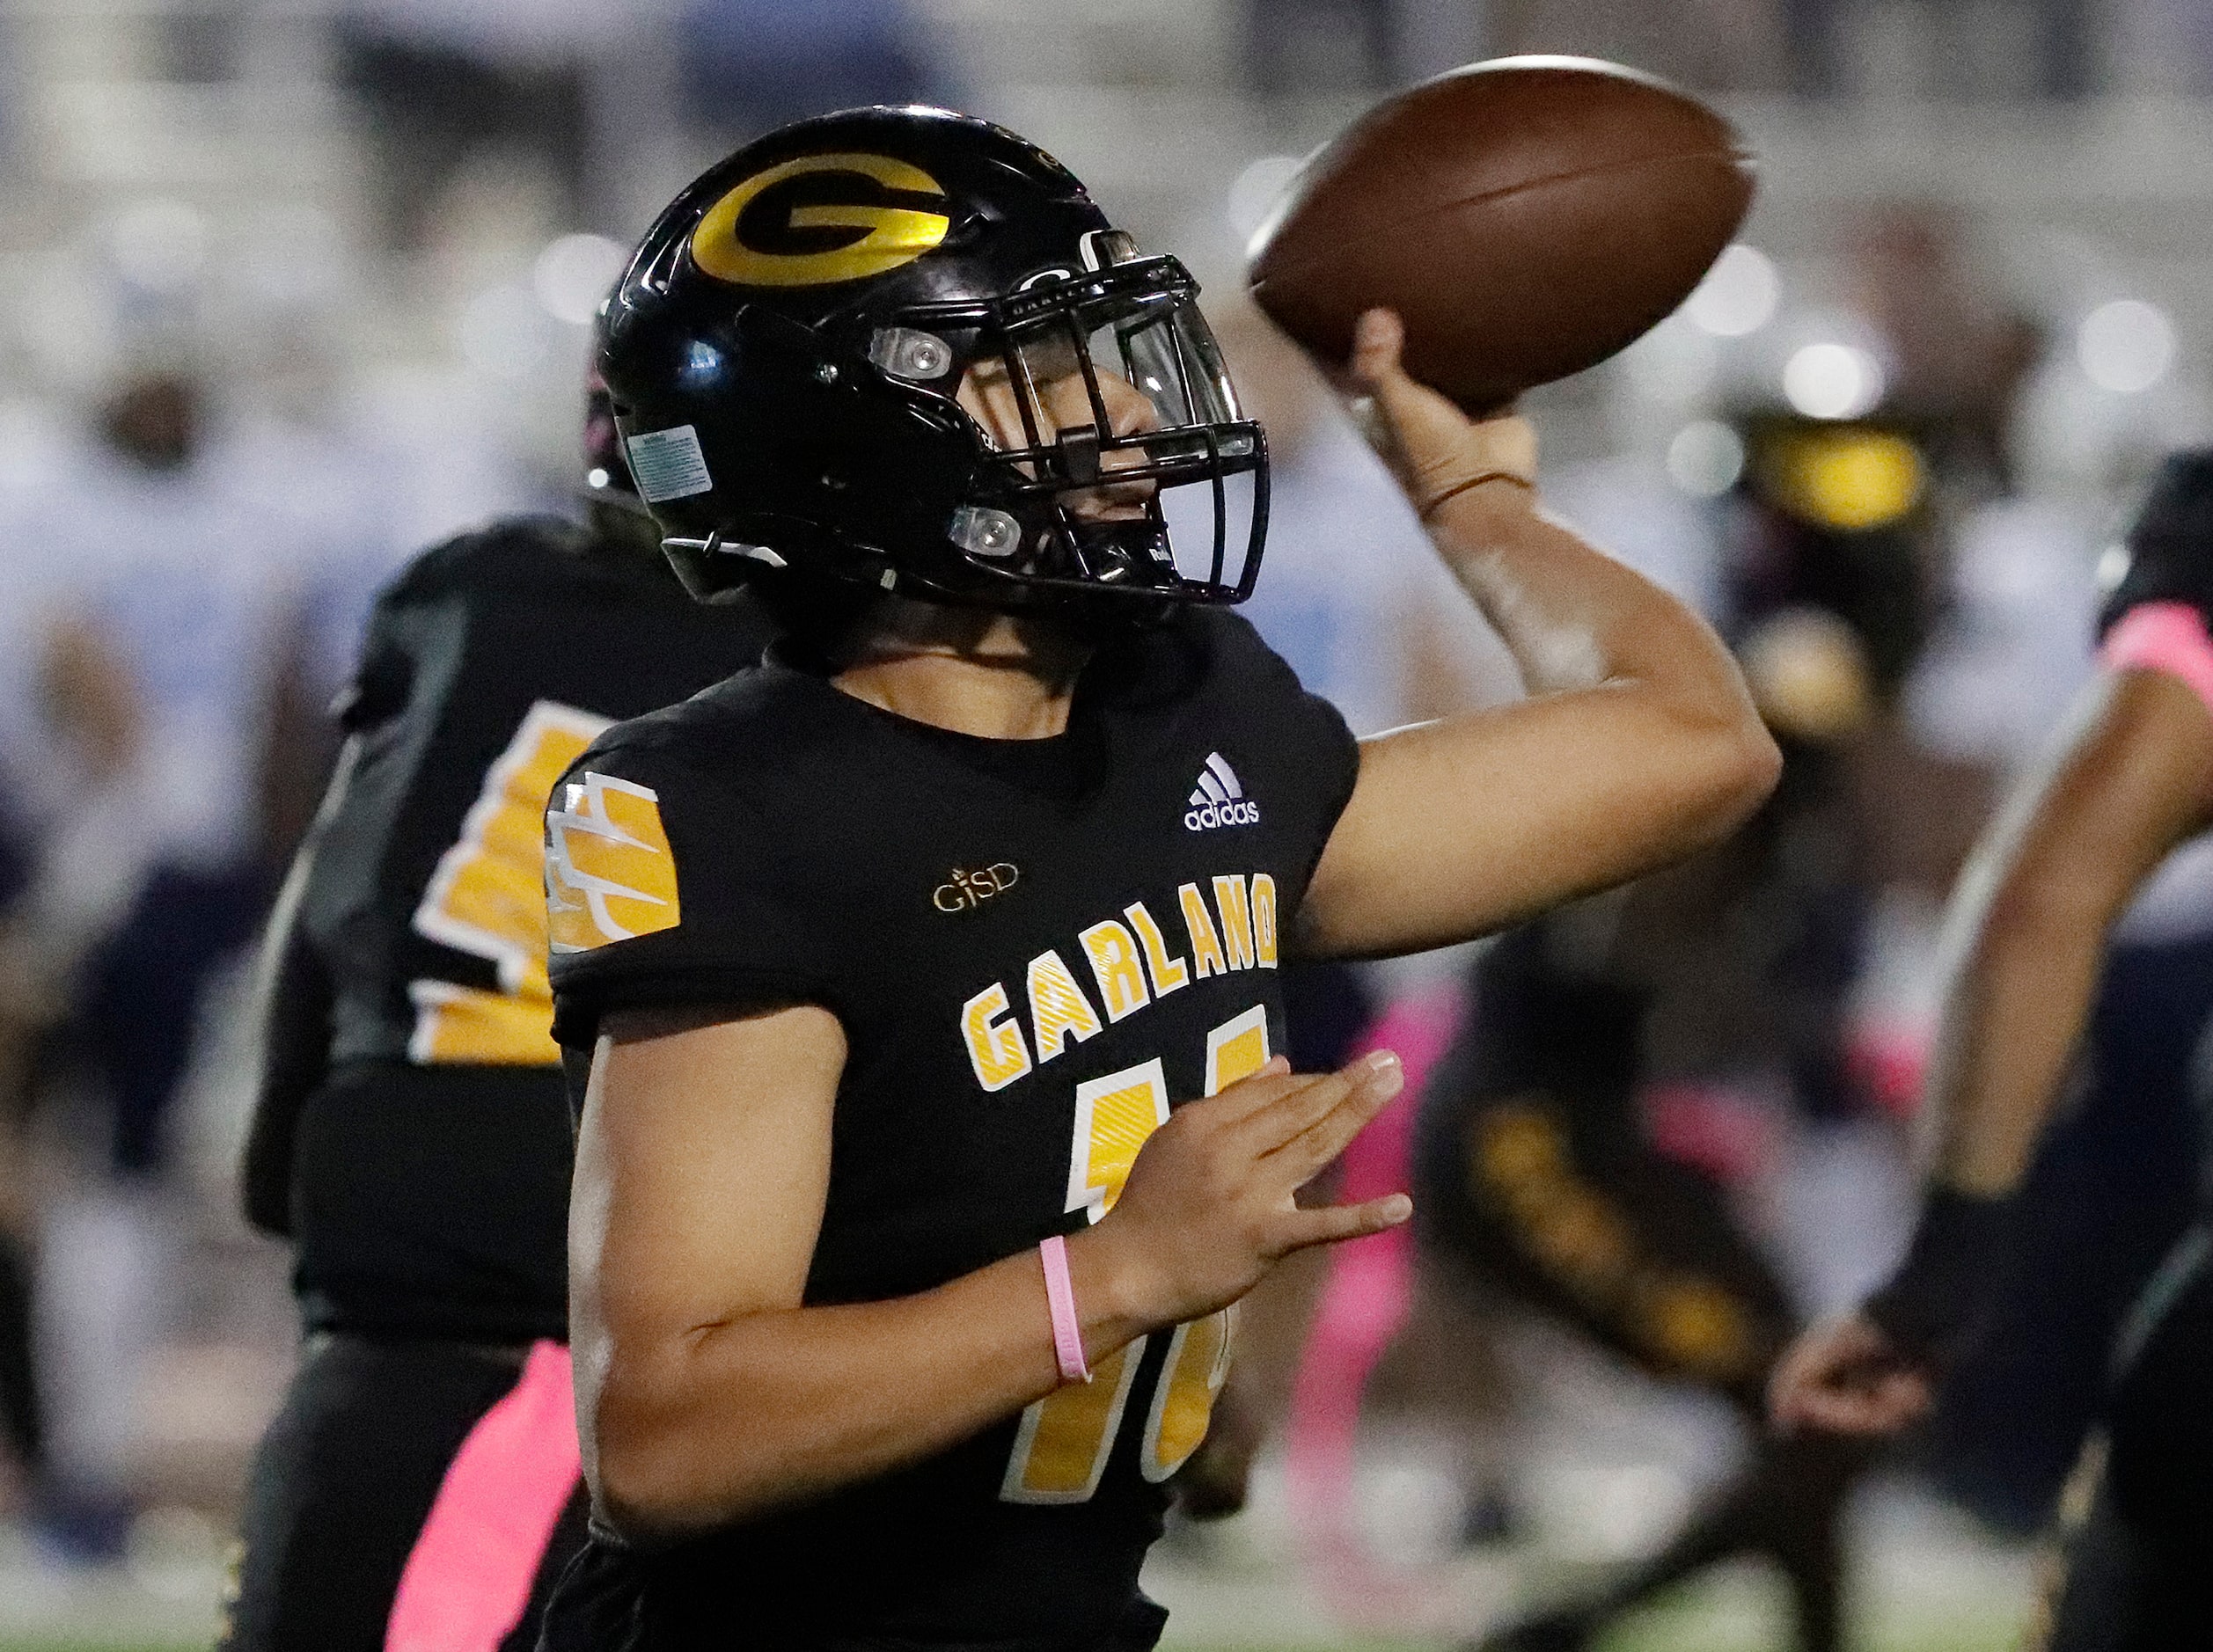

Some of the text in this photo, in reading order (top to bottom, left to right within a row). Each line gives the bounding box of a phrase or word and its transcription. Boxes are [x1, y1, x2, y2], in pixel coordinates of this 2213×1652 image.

[691, 153, 949, 286] G
[1183, 799, 1259, 831] adidas
[960, 873, 1278, 1093] GARLAND
